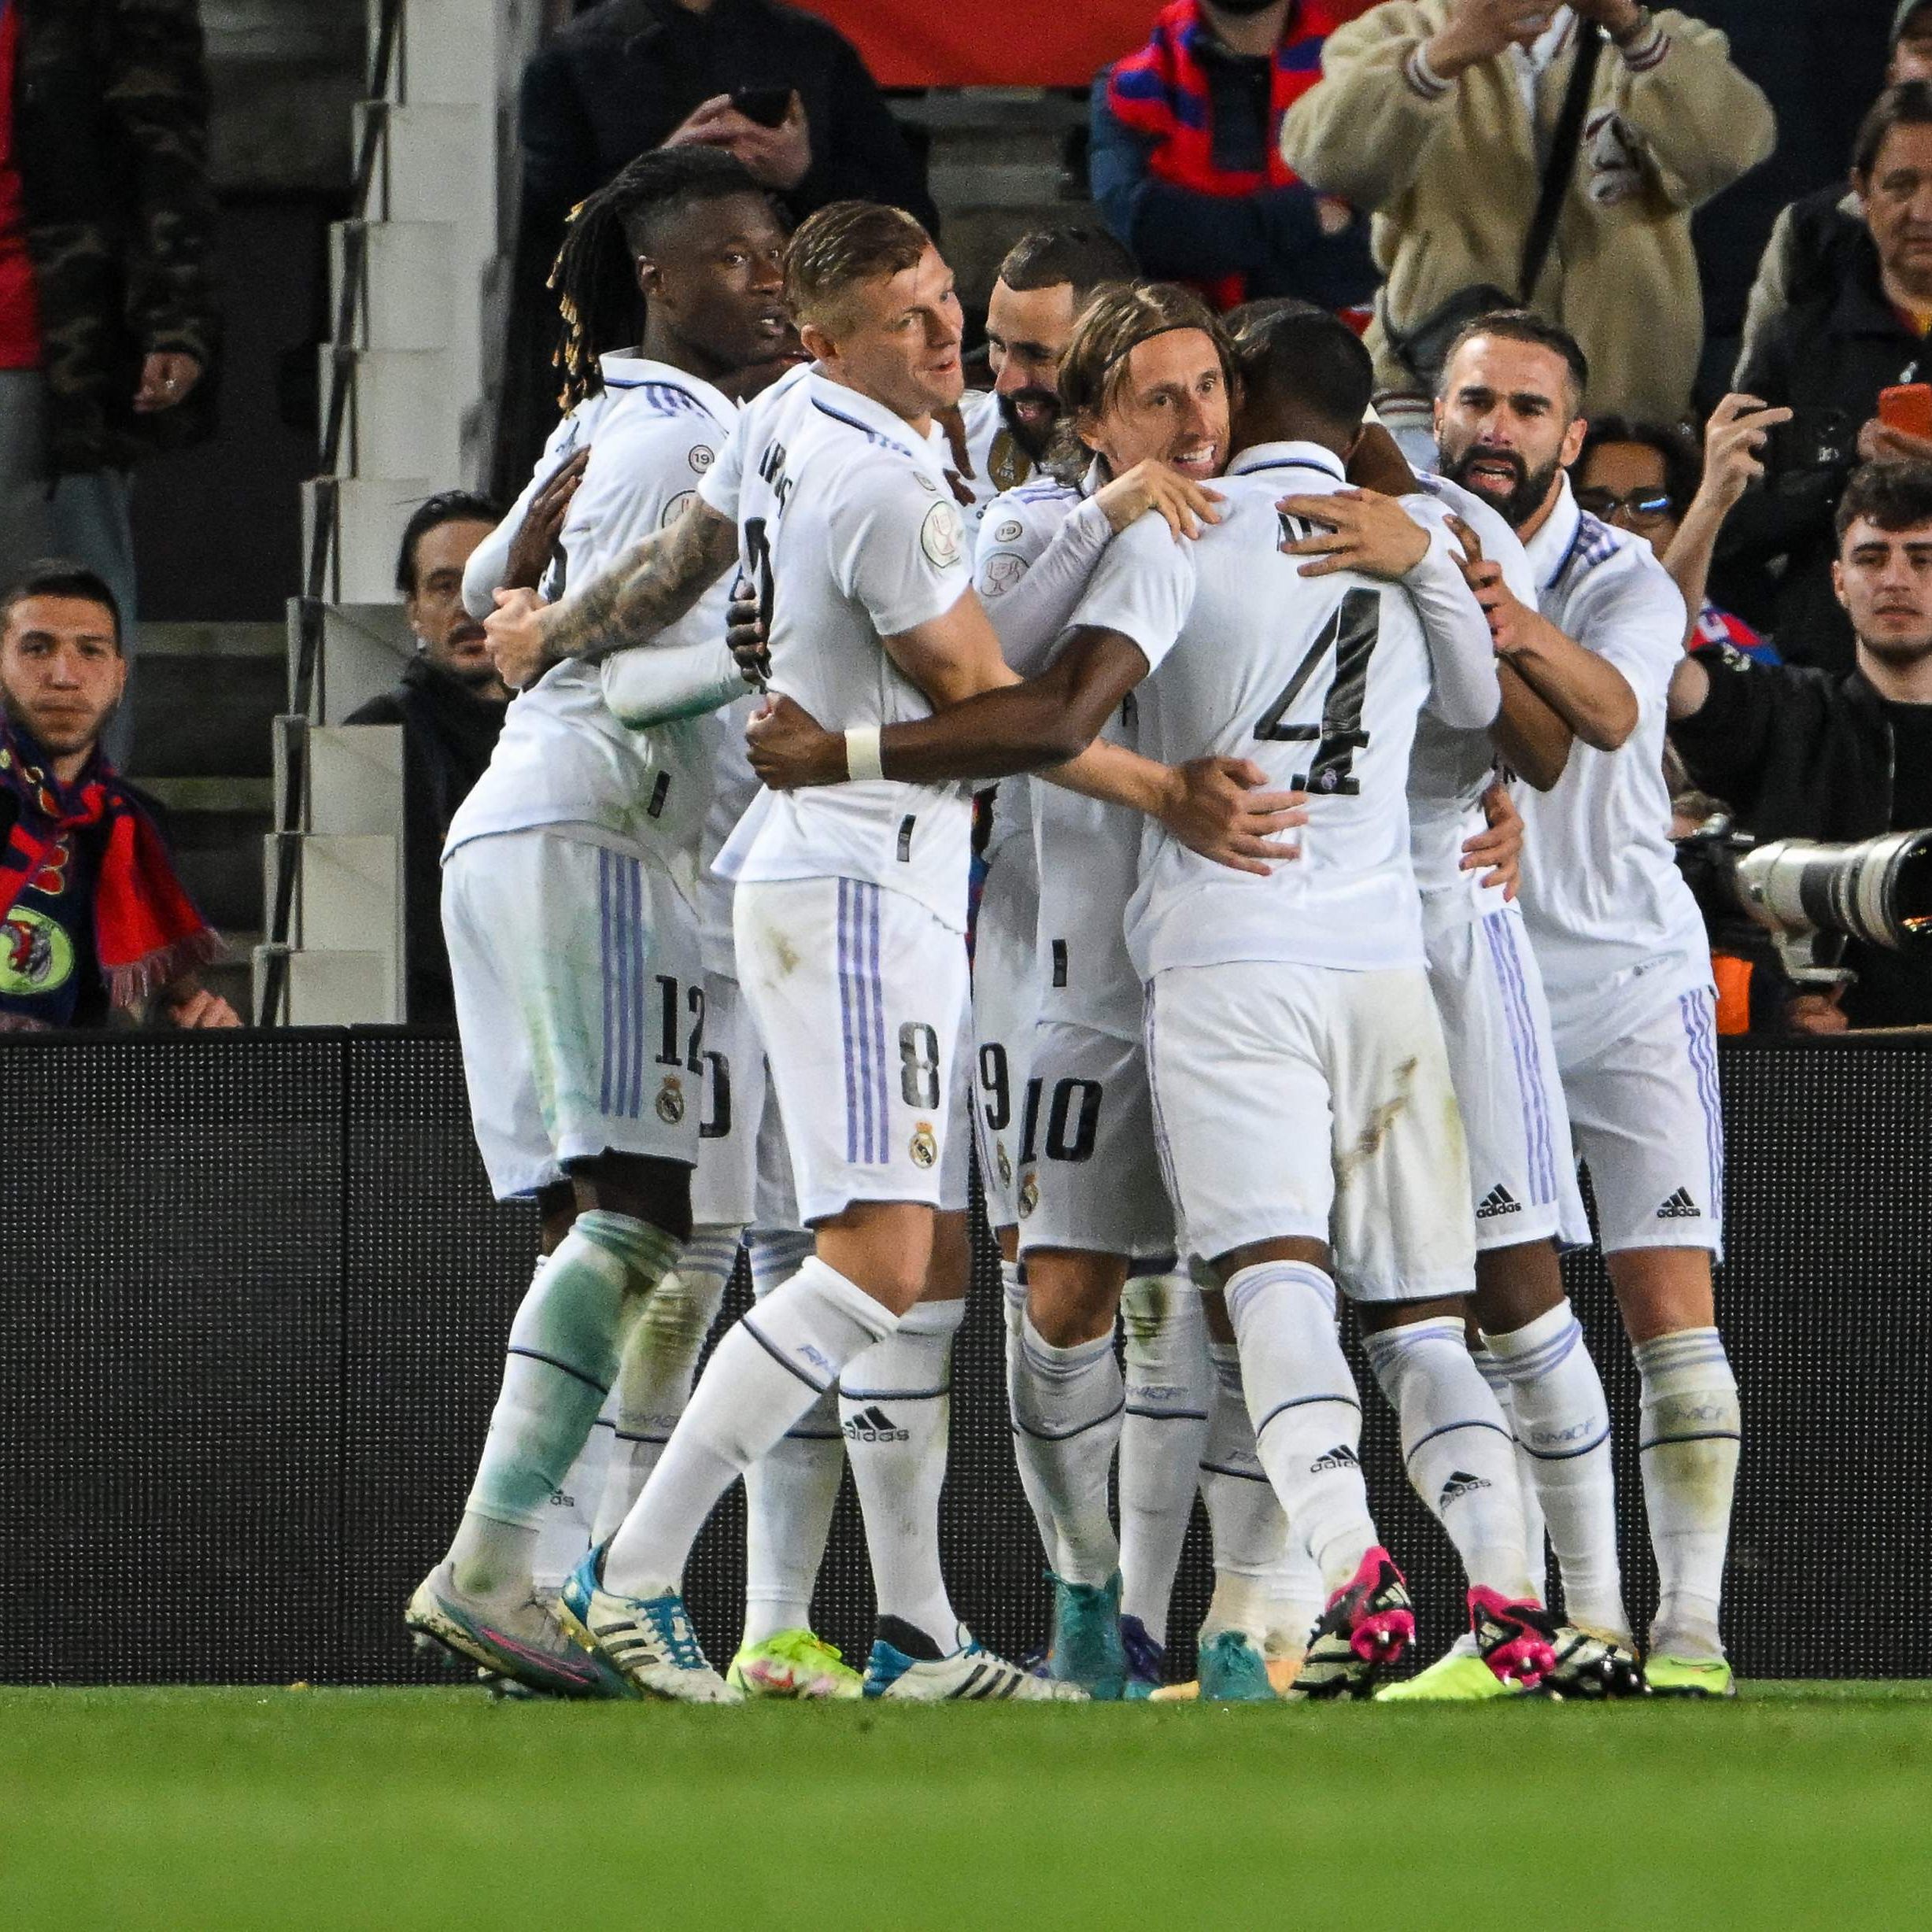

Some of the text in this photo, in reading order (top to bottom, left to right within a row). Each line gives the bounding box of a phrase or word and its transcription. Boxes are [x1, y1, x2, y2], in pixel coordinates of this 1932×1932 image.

[693, 454, 710, 465] 19
[1254, 586, 1380, 796] 4
[656, 974, 705, 1077] 12
[899, 1021, 940, 1110] 8
[980, 1042, 1010, 1130] 9
[1020, 1077, 1103, 1162] 10
[1476, 1202, 1522, 1219] adidas
[1657, 1205, 1701, 1218] adidas
